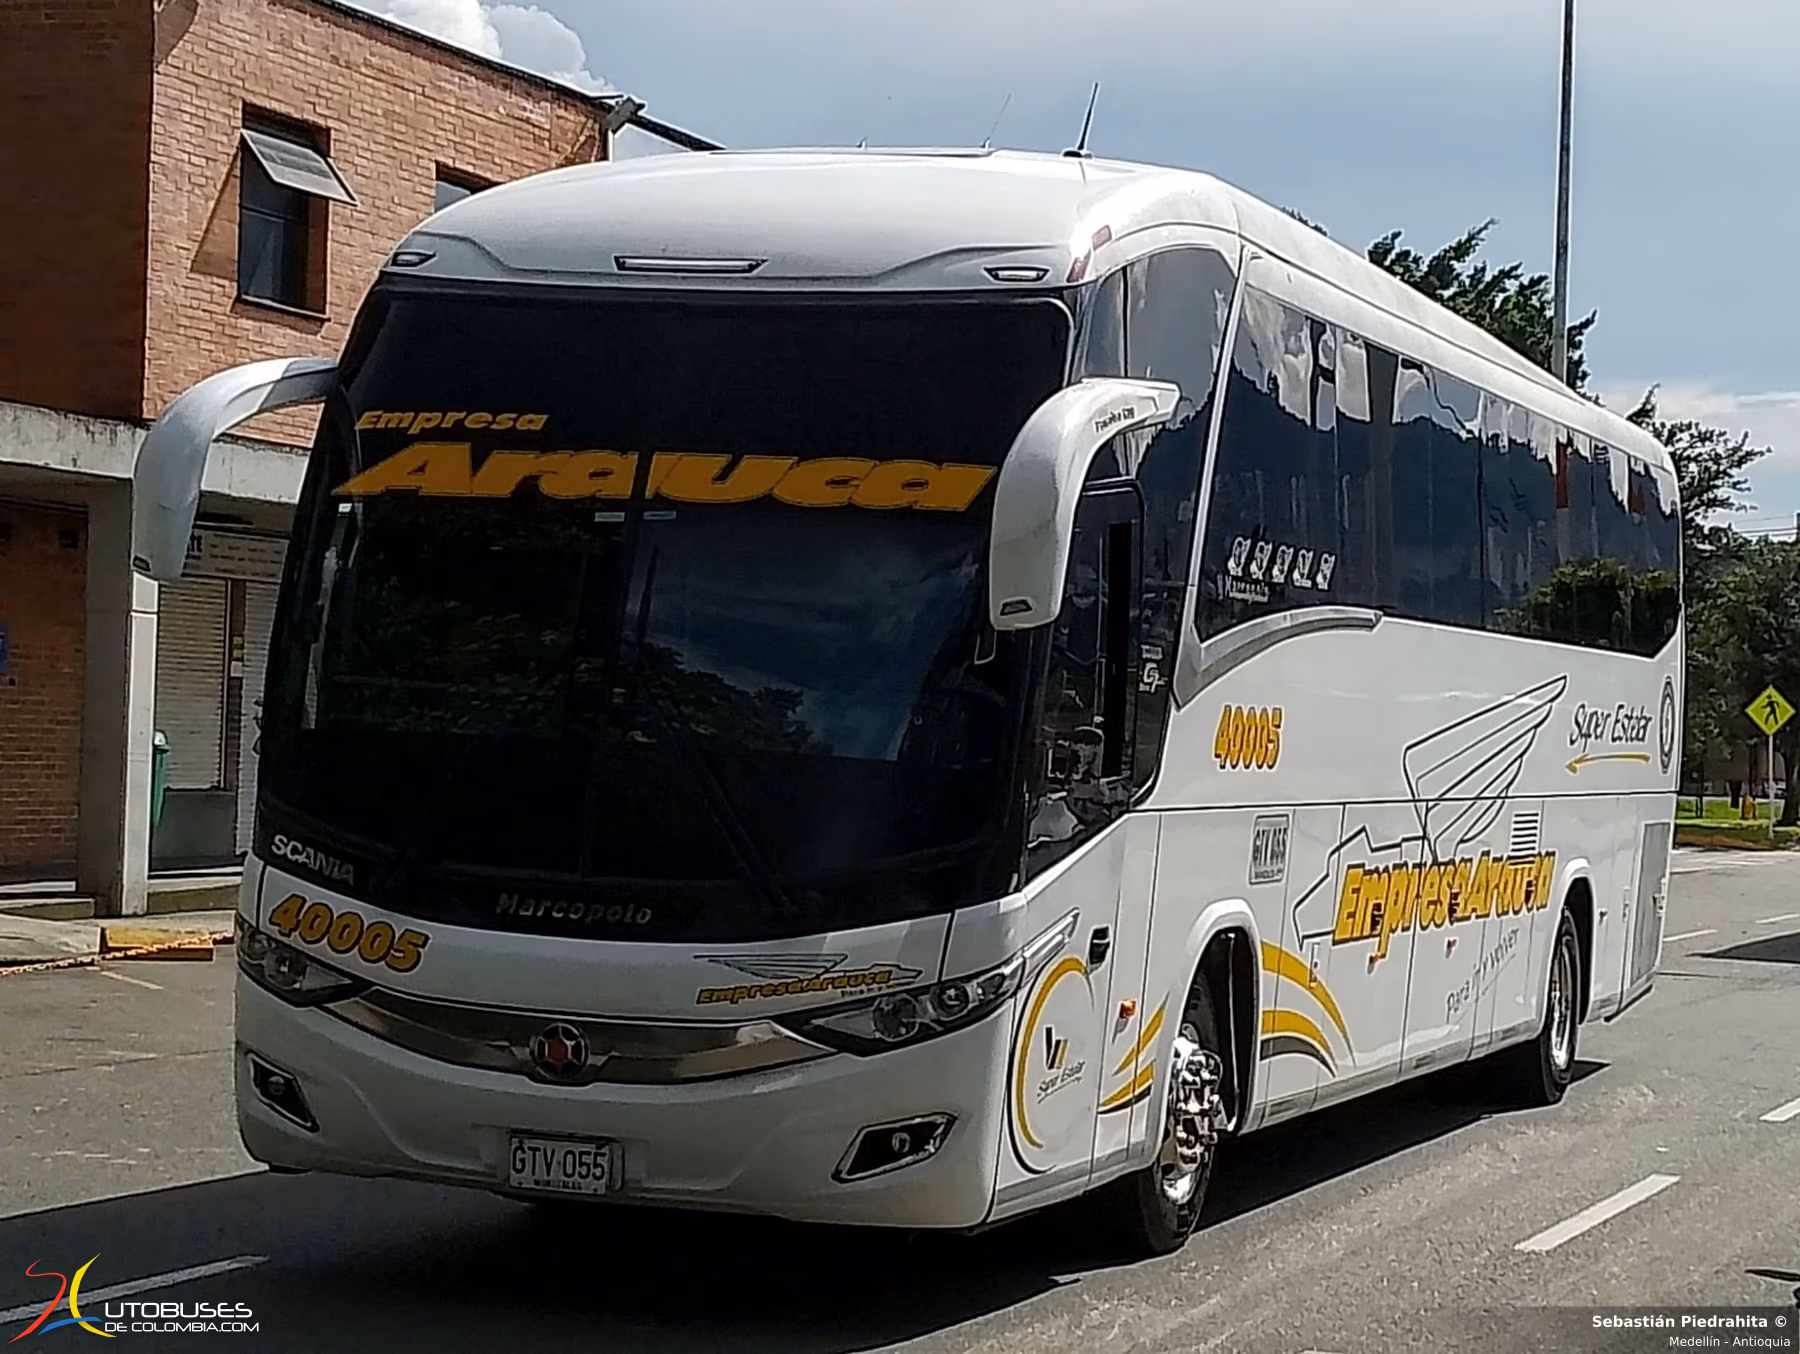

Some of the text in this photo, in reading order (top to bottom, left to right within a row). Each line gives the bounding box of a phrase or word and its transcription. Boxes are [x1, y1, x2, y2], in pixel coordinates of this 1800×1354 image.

[355, 410, 548, 434] Empresa
[330, 441, 998, 512] Arauca
[1214, 705, 1282, 770] 40005
[1569, 703, 1611, 753] Super
[271, 834, 354, 886] SCANIA
[268, 893, 433, 973] 40005
[495, 893, 652, 926] Marcopolo
[512, 1145, 607, 1181] GTV 055
